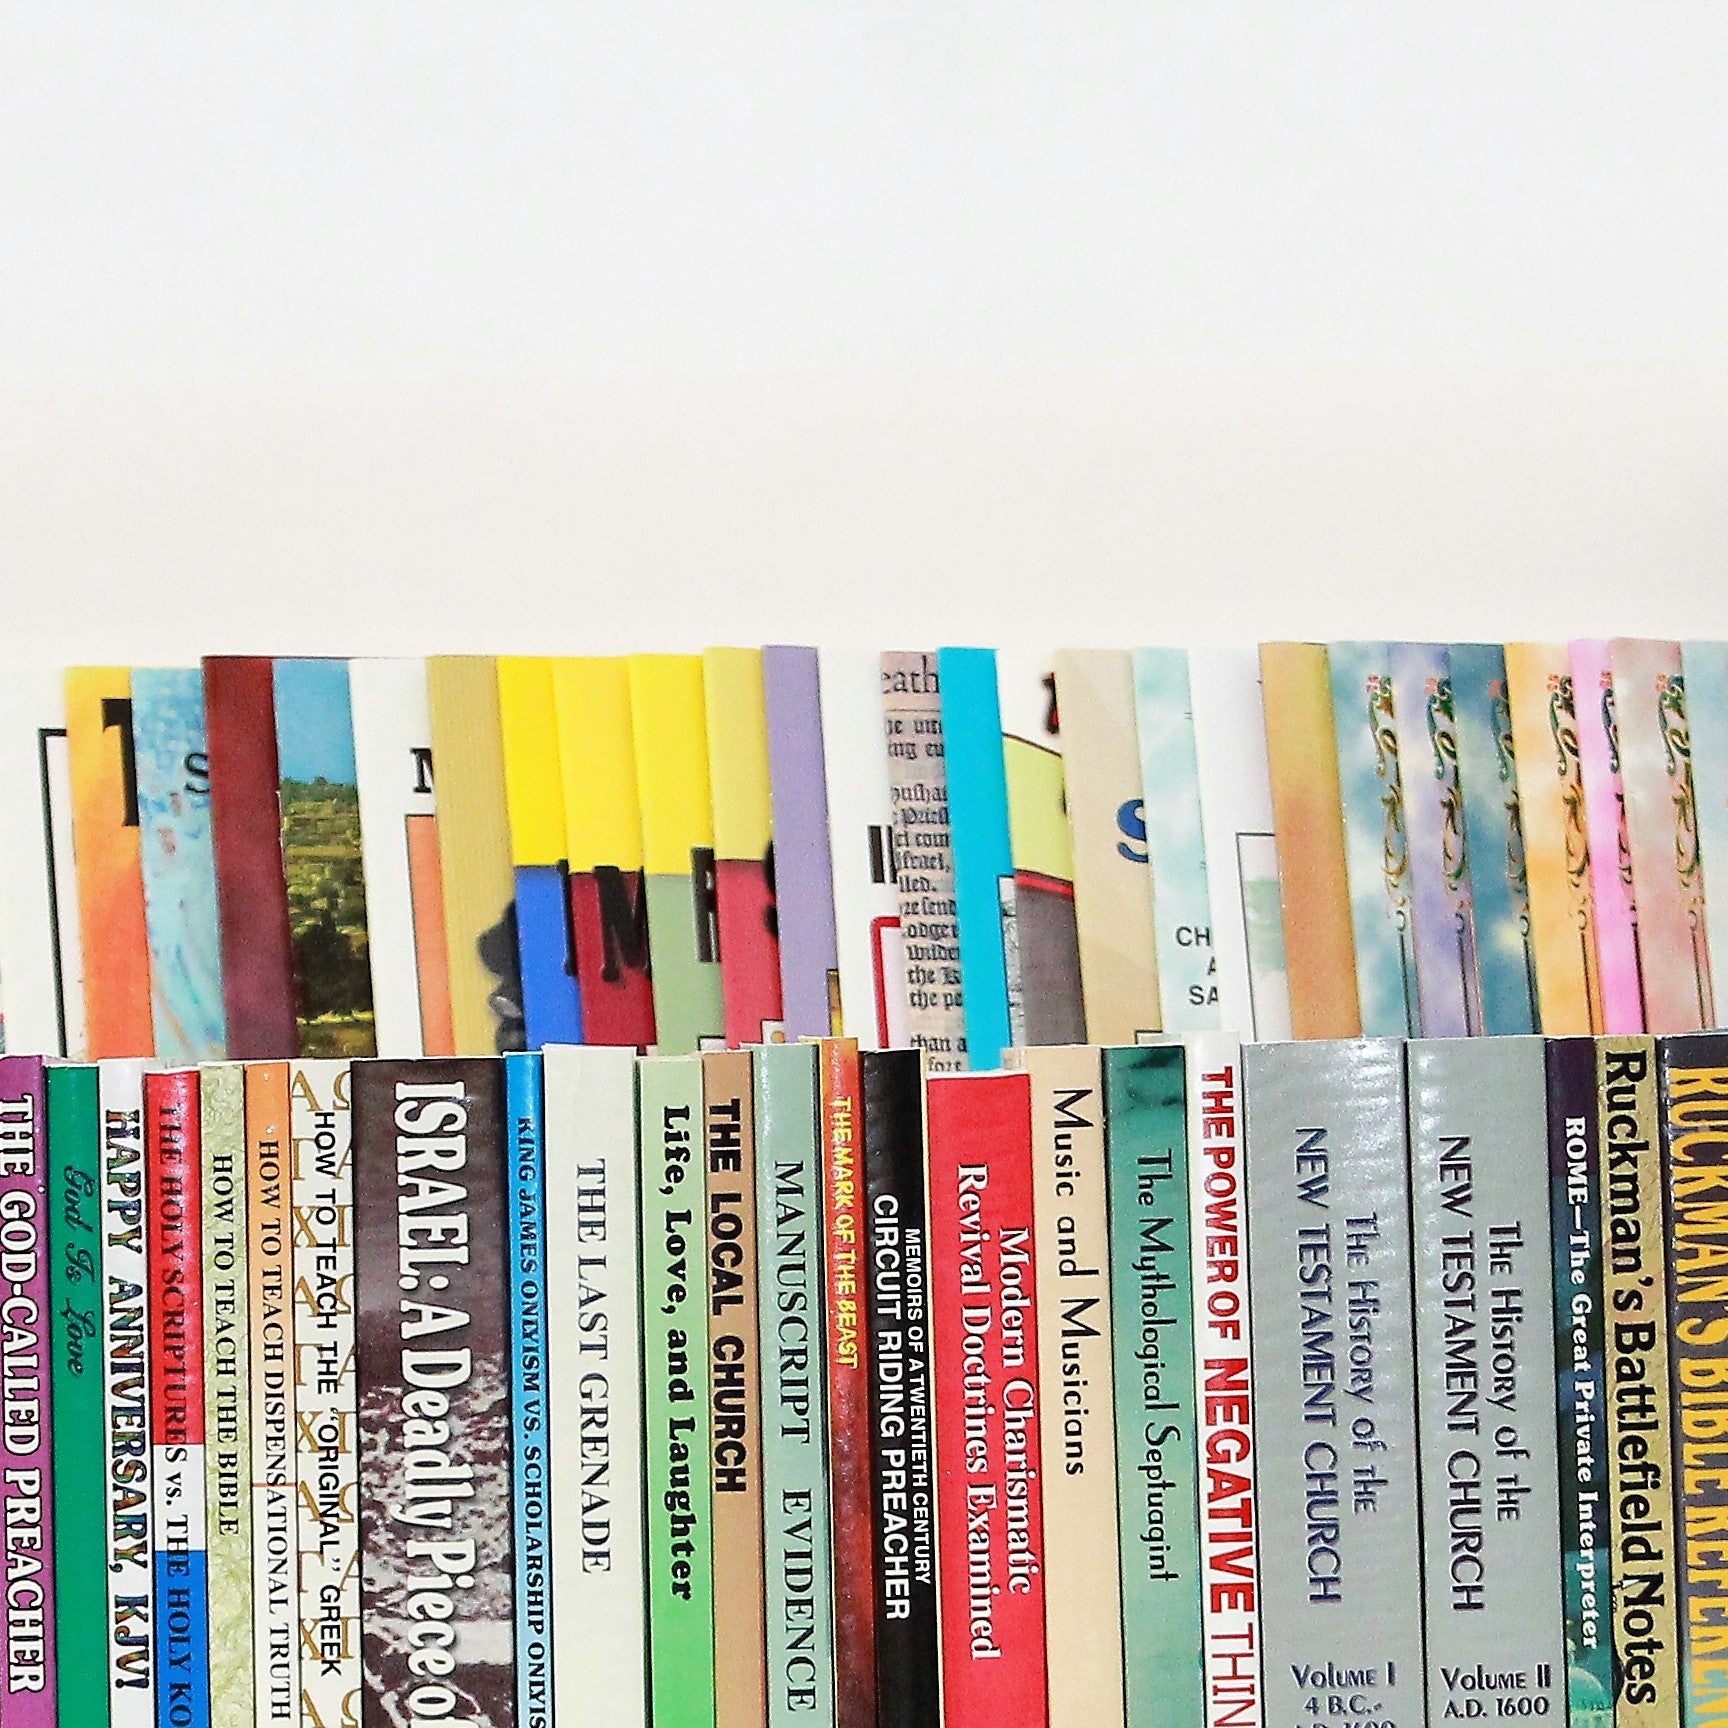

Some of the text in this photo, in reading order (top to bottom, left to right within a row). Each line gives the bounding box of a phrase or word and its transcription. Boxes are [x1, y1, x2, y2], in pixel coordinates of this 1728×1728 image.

[393, 1081, 471, 1292] ISRAEL:
[399, 1301, 471, 1339] A
[660, 1106, 699, 1601] Life, Love, and Laughter
[1202, 1066, 1256, 1614] THE POWER OF NEGATIVE
[1295, 1126, 1342, 1603] NEW TESTAMENT CHURCH
[1606, 1050, 1667, 1704] Ruckman's Battlefield Notes
[391, 1348, 474, 1530] Deadly
[406, 1540, 477, 1677] Piece
[874, 1194, 911, 1621] CIRCUIT RIDING PREACHER
